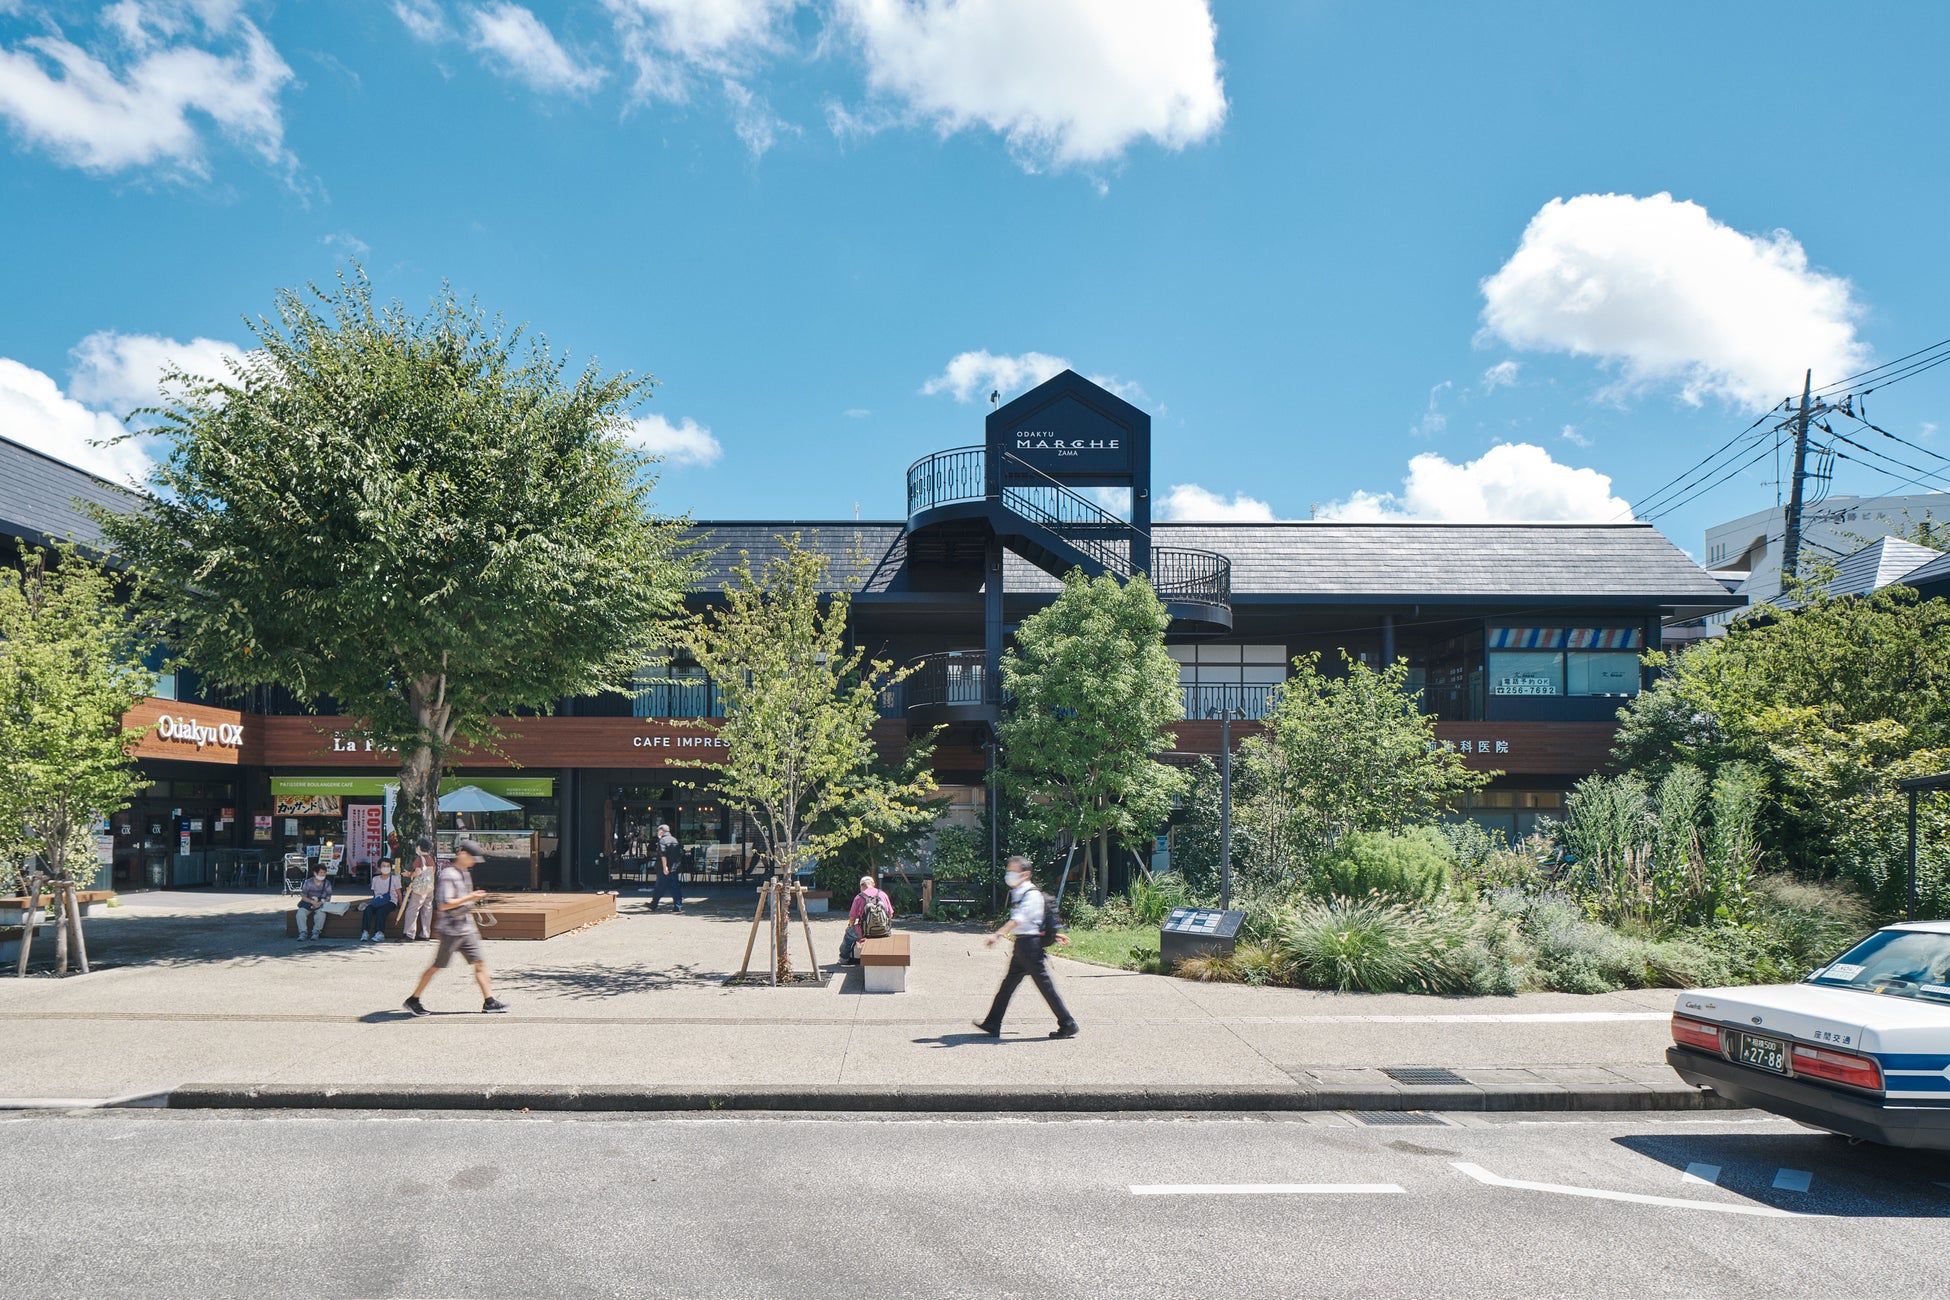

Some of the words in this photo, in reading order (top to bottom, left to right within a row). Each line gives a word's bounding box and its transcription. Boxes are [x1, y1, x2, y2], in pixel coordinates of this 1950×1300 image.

[1017, 439, 1119, 449] MARCHE
[158, 714, 217, 747] Odakyu
[218, 722, 244, 746] OX
[333, 737, 357, 752] La
[633, 736, 671, 747] CAFE
[1764, 1040, 1777, 1051] 500
[1750, 1047, 1783, 1069] 27-88
